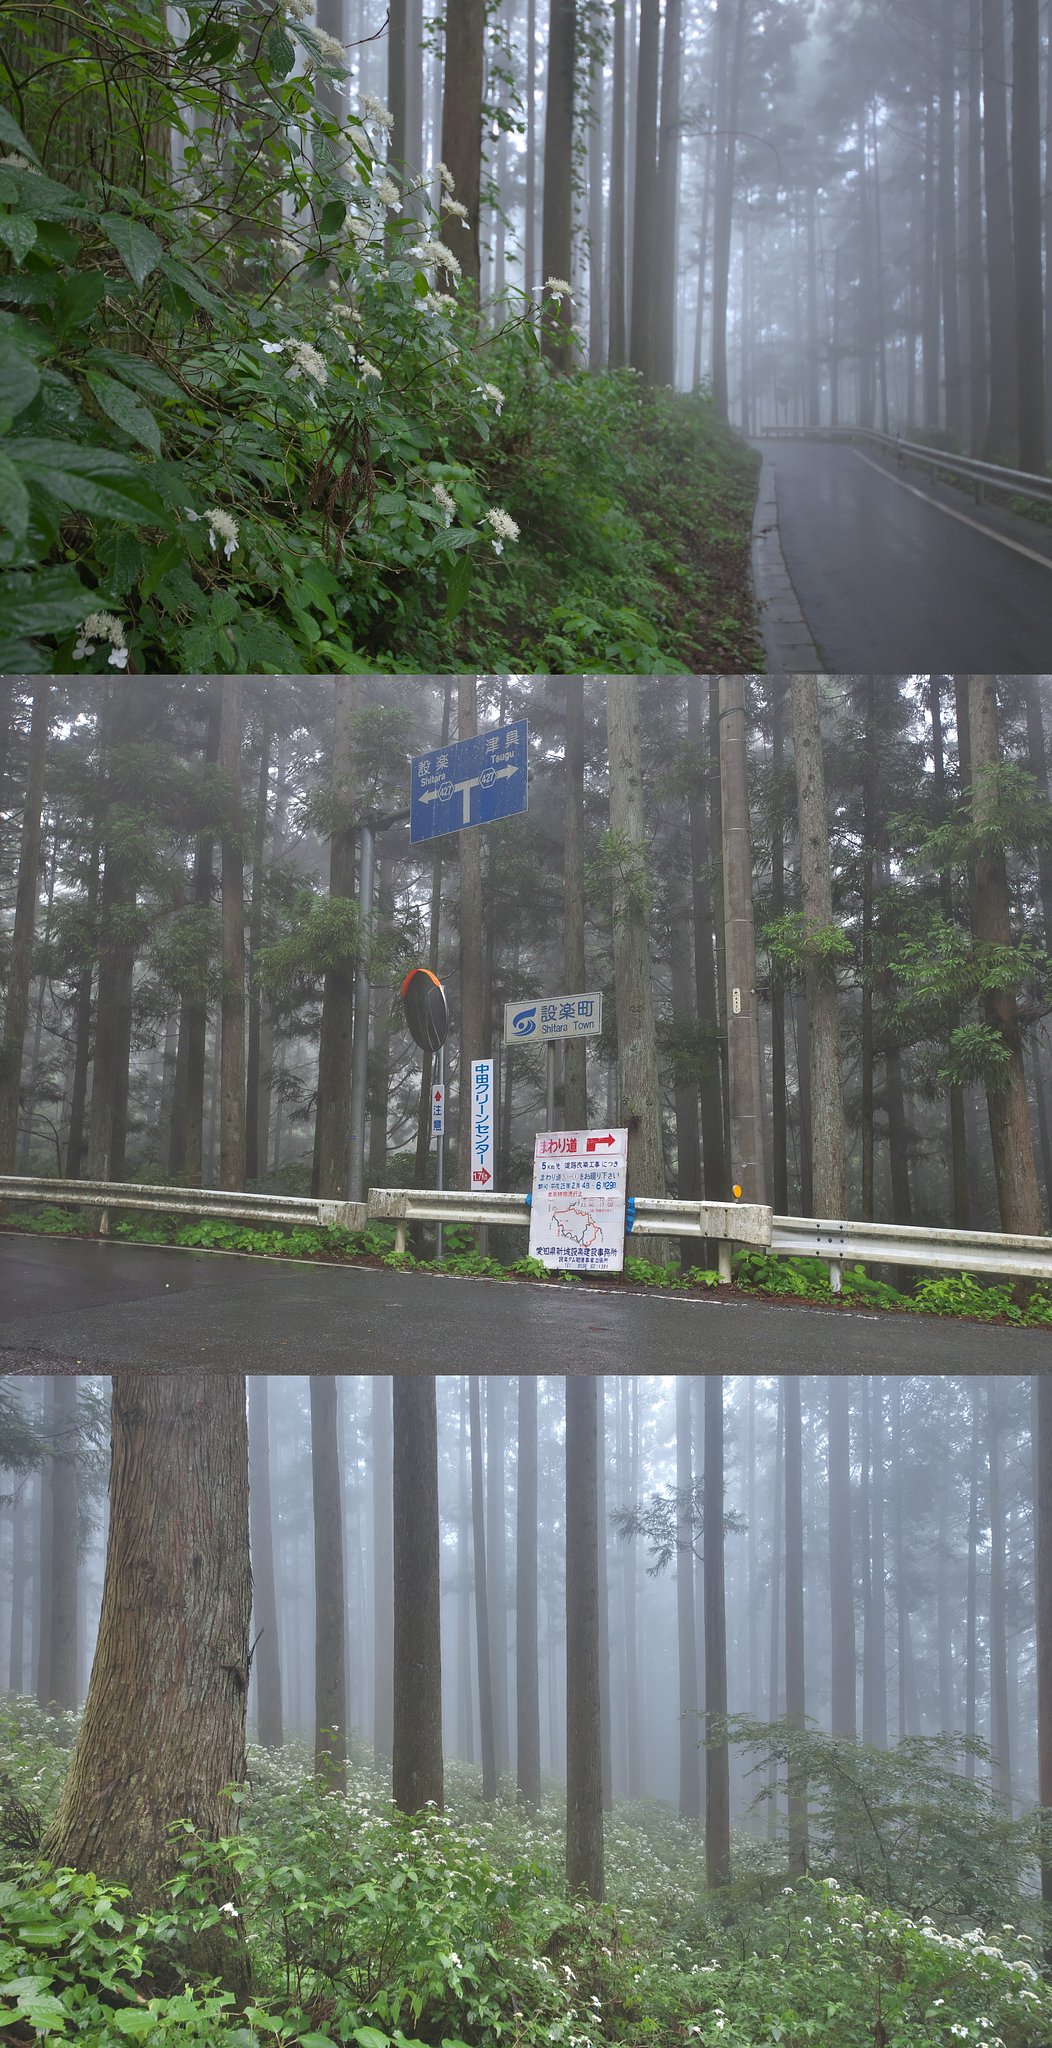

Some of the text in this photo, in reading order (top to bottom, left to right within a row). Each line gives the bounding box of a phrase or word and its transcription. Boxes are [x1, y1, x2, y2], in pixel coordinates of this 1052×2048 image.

[485, 729, 520, 755] 津具
[490, 750, 515, 764] Tsugu
[418, 753, 449, 777] 設楽
[420, 773, 446, 787] Shitara
[481, 772, 494, 784] 427
[439, 785, 452, 797] 427
[541, 1000, 595, 1022] 設楽町
[541, 1020, 595, 1035] Shitara Town
[433, 1105, 442, 1131] 注意
[475, 1063, 490, 1165] 中田クリーンセンター
[540, 1138, 577, 1153] まわり道
